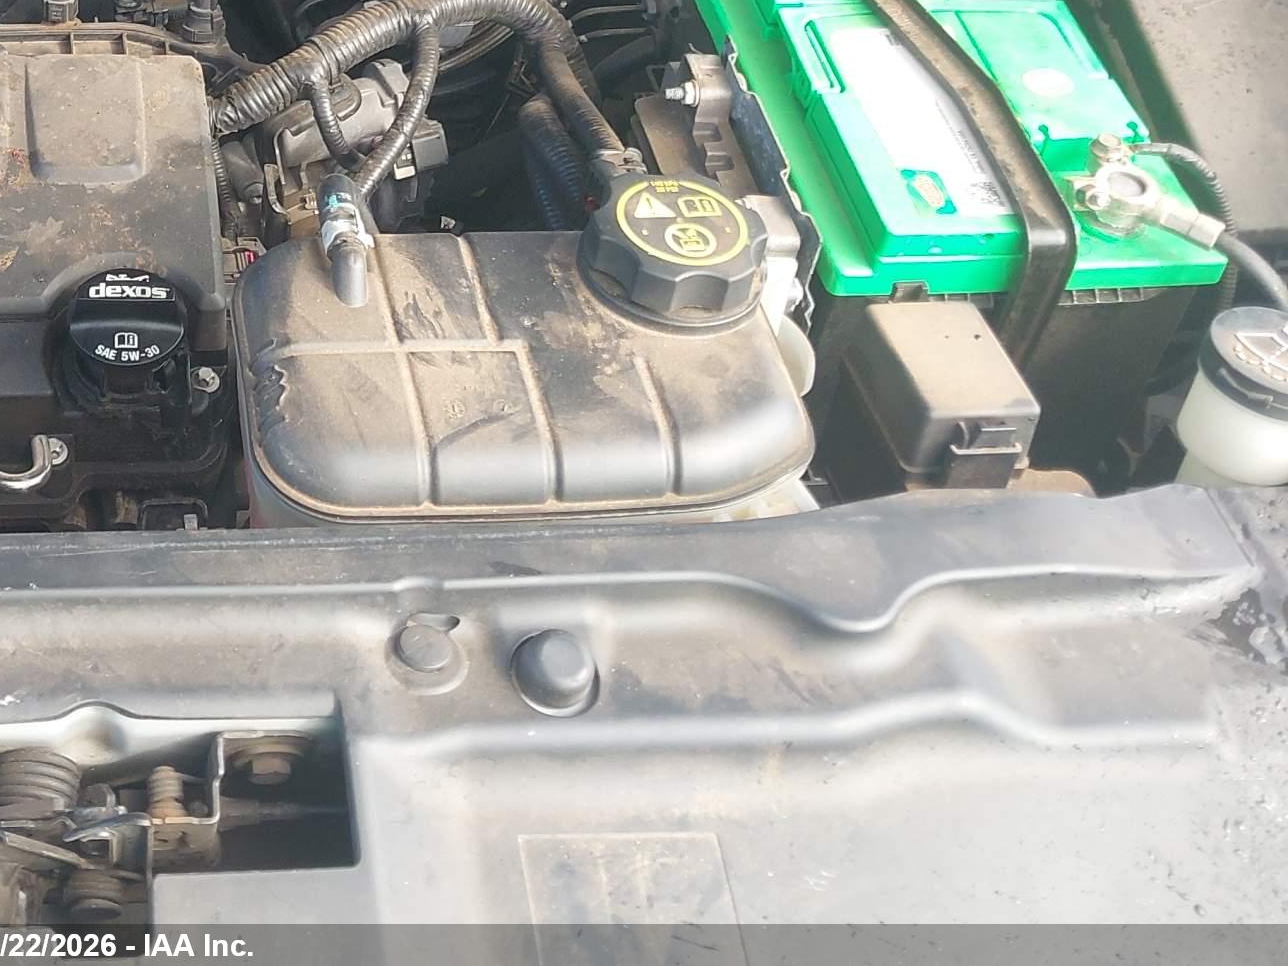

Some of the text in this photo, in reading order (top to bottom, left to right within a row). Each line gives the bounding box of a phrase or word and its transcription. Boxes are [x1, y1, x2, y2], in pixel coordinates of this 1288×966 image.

[88, 282, 169, 299] dexos
[95, 344, 160, 361] SAE 5W-30
